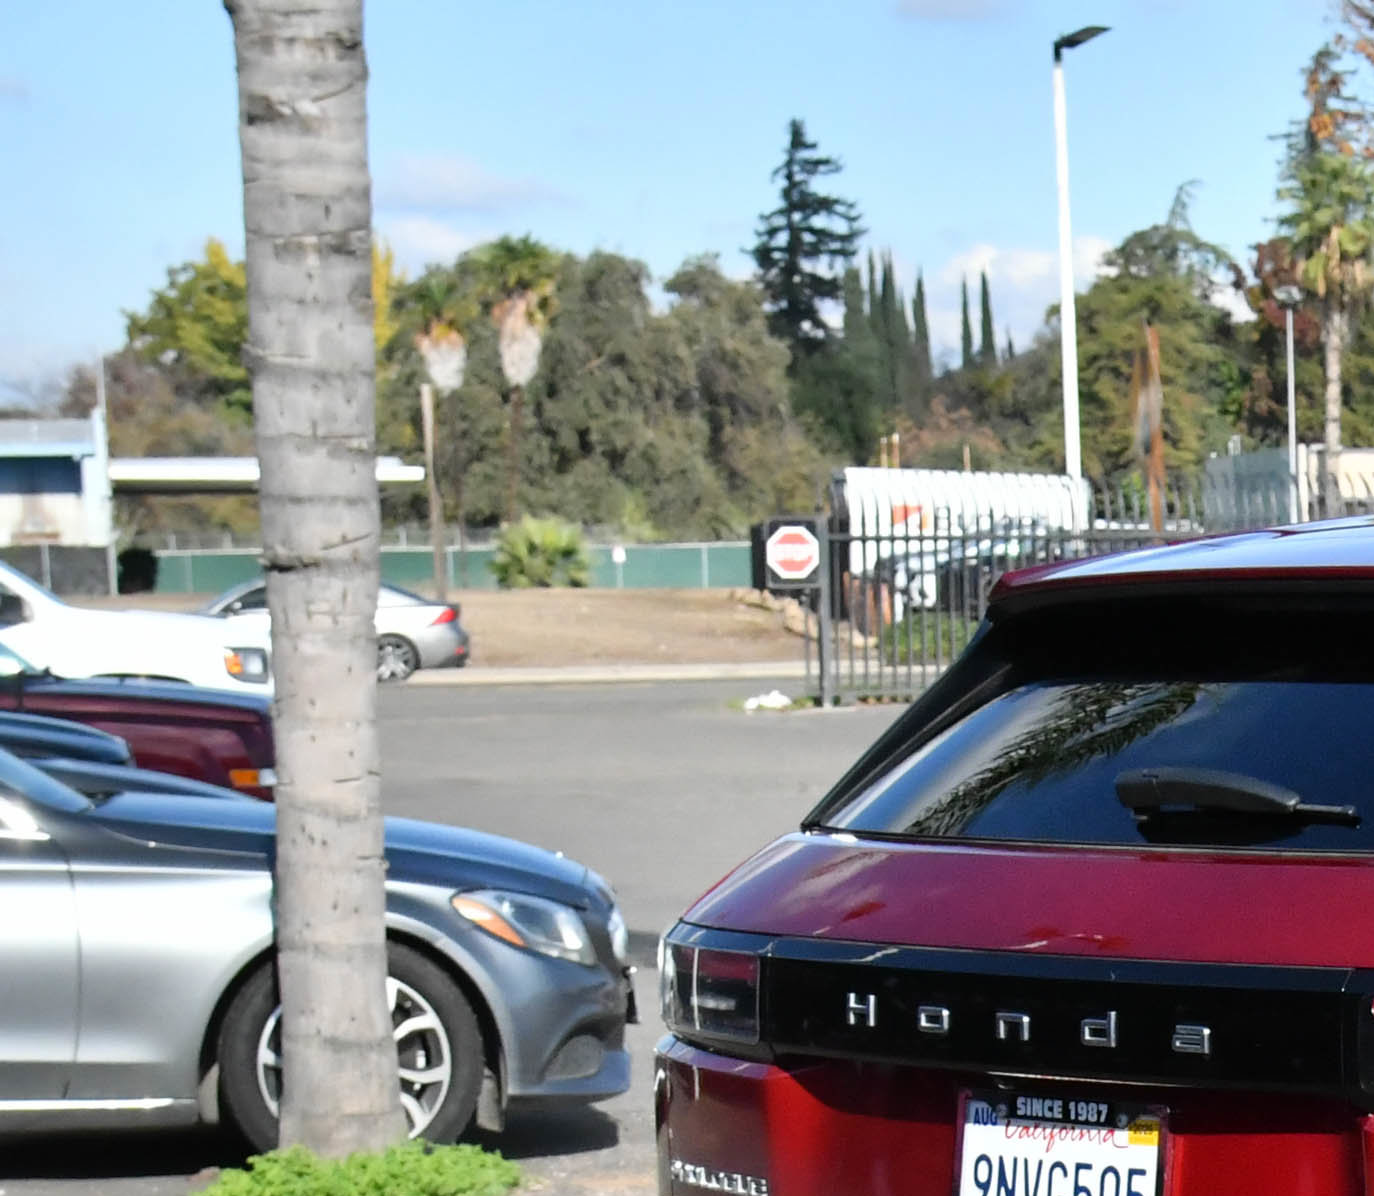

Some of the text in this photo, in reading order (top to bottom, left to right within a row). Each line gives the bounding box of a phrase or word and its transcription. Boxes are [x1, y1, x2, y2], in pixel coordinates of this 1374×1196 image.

[846, 992, 1212, 1056] Honda
[973, 1106, 998, 1126] AUG
[1016, 1096, 1108, 1123] SINCE 1987
[1004, 1118, 1129, 1153] California
